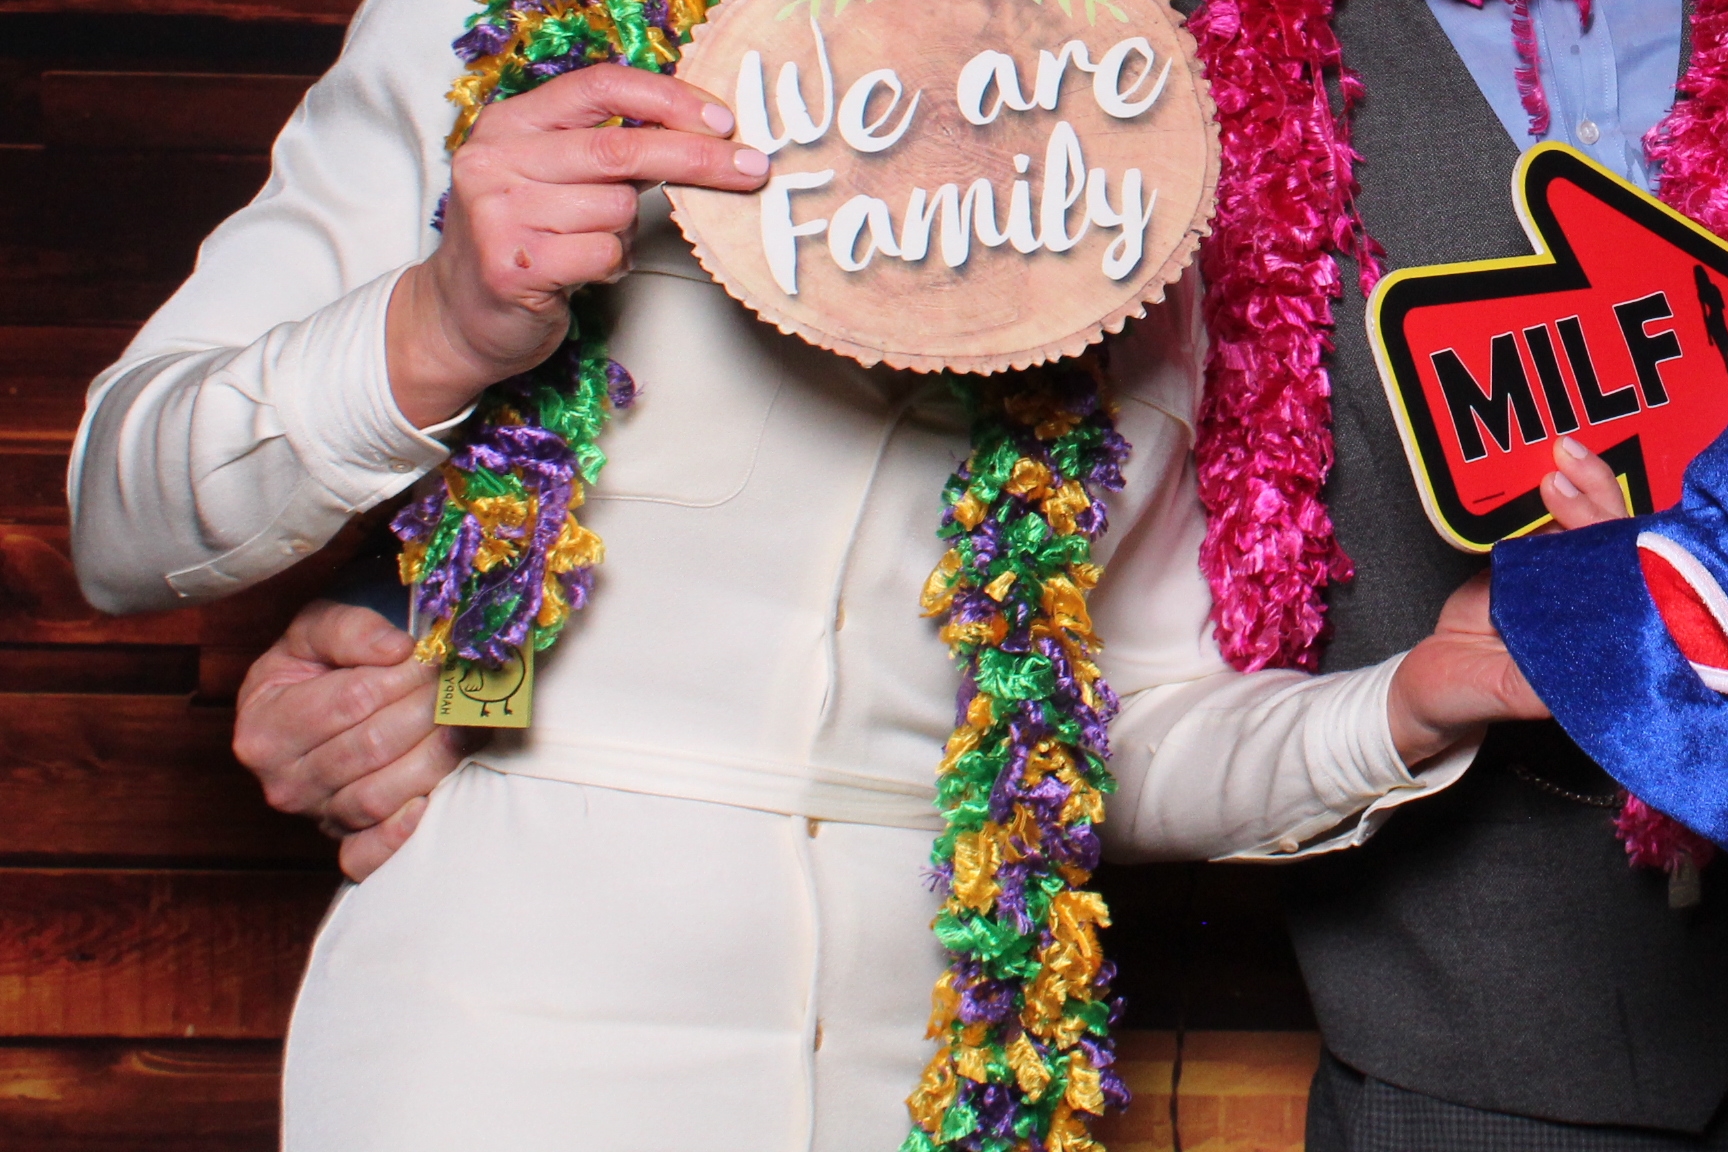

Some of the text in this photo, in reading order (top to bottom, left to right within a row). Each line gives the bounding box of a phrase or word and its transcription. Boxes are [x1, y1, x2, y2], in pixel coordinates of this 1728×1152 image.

[735, 16, 1173, 155] We are
[760, 120, 1158, 295] Family
[1429, 290, 1684, 464] MILF
